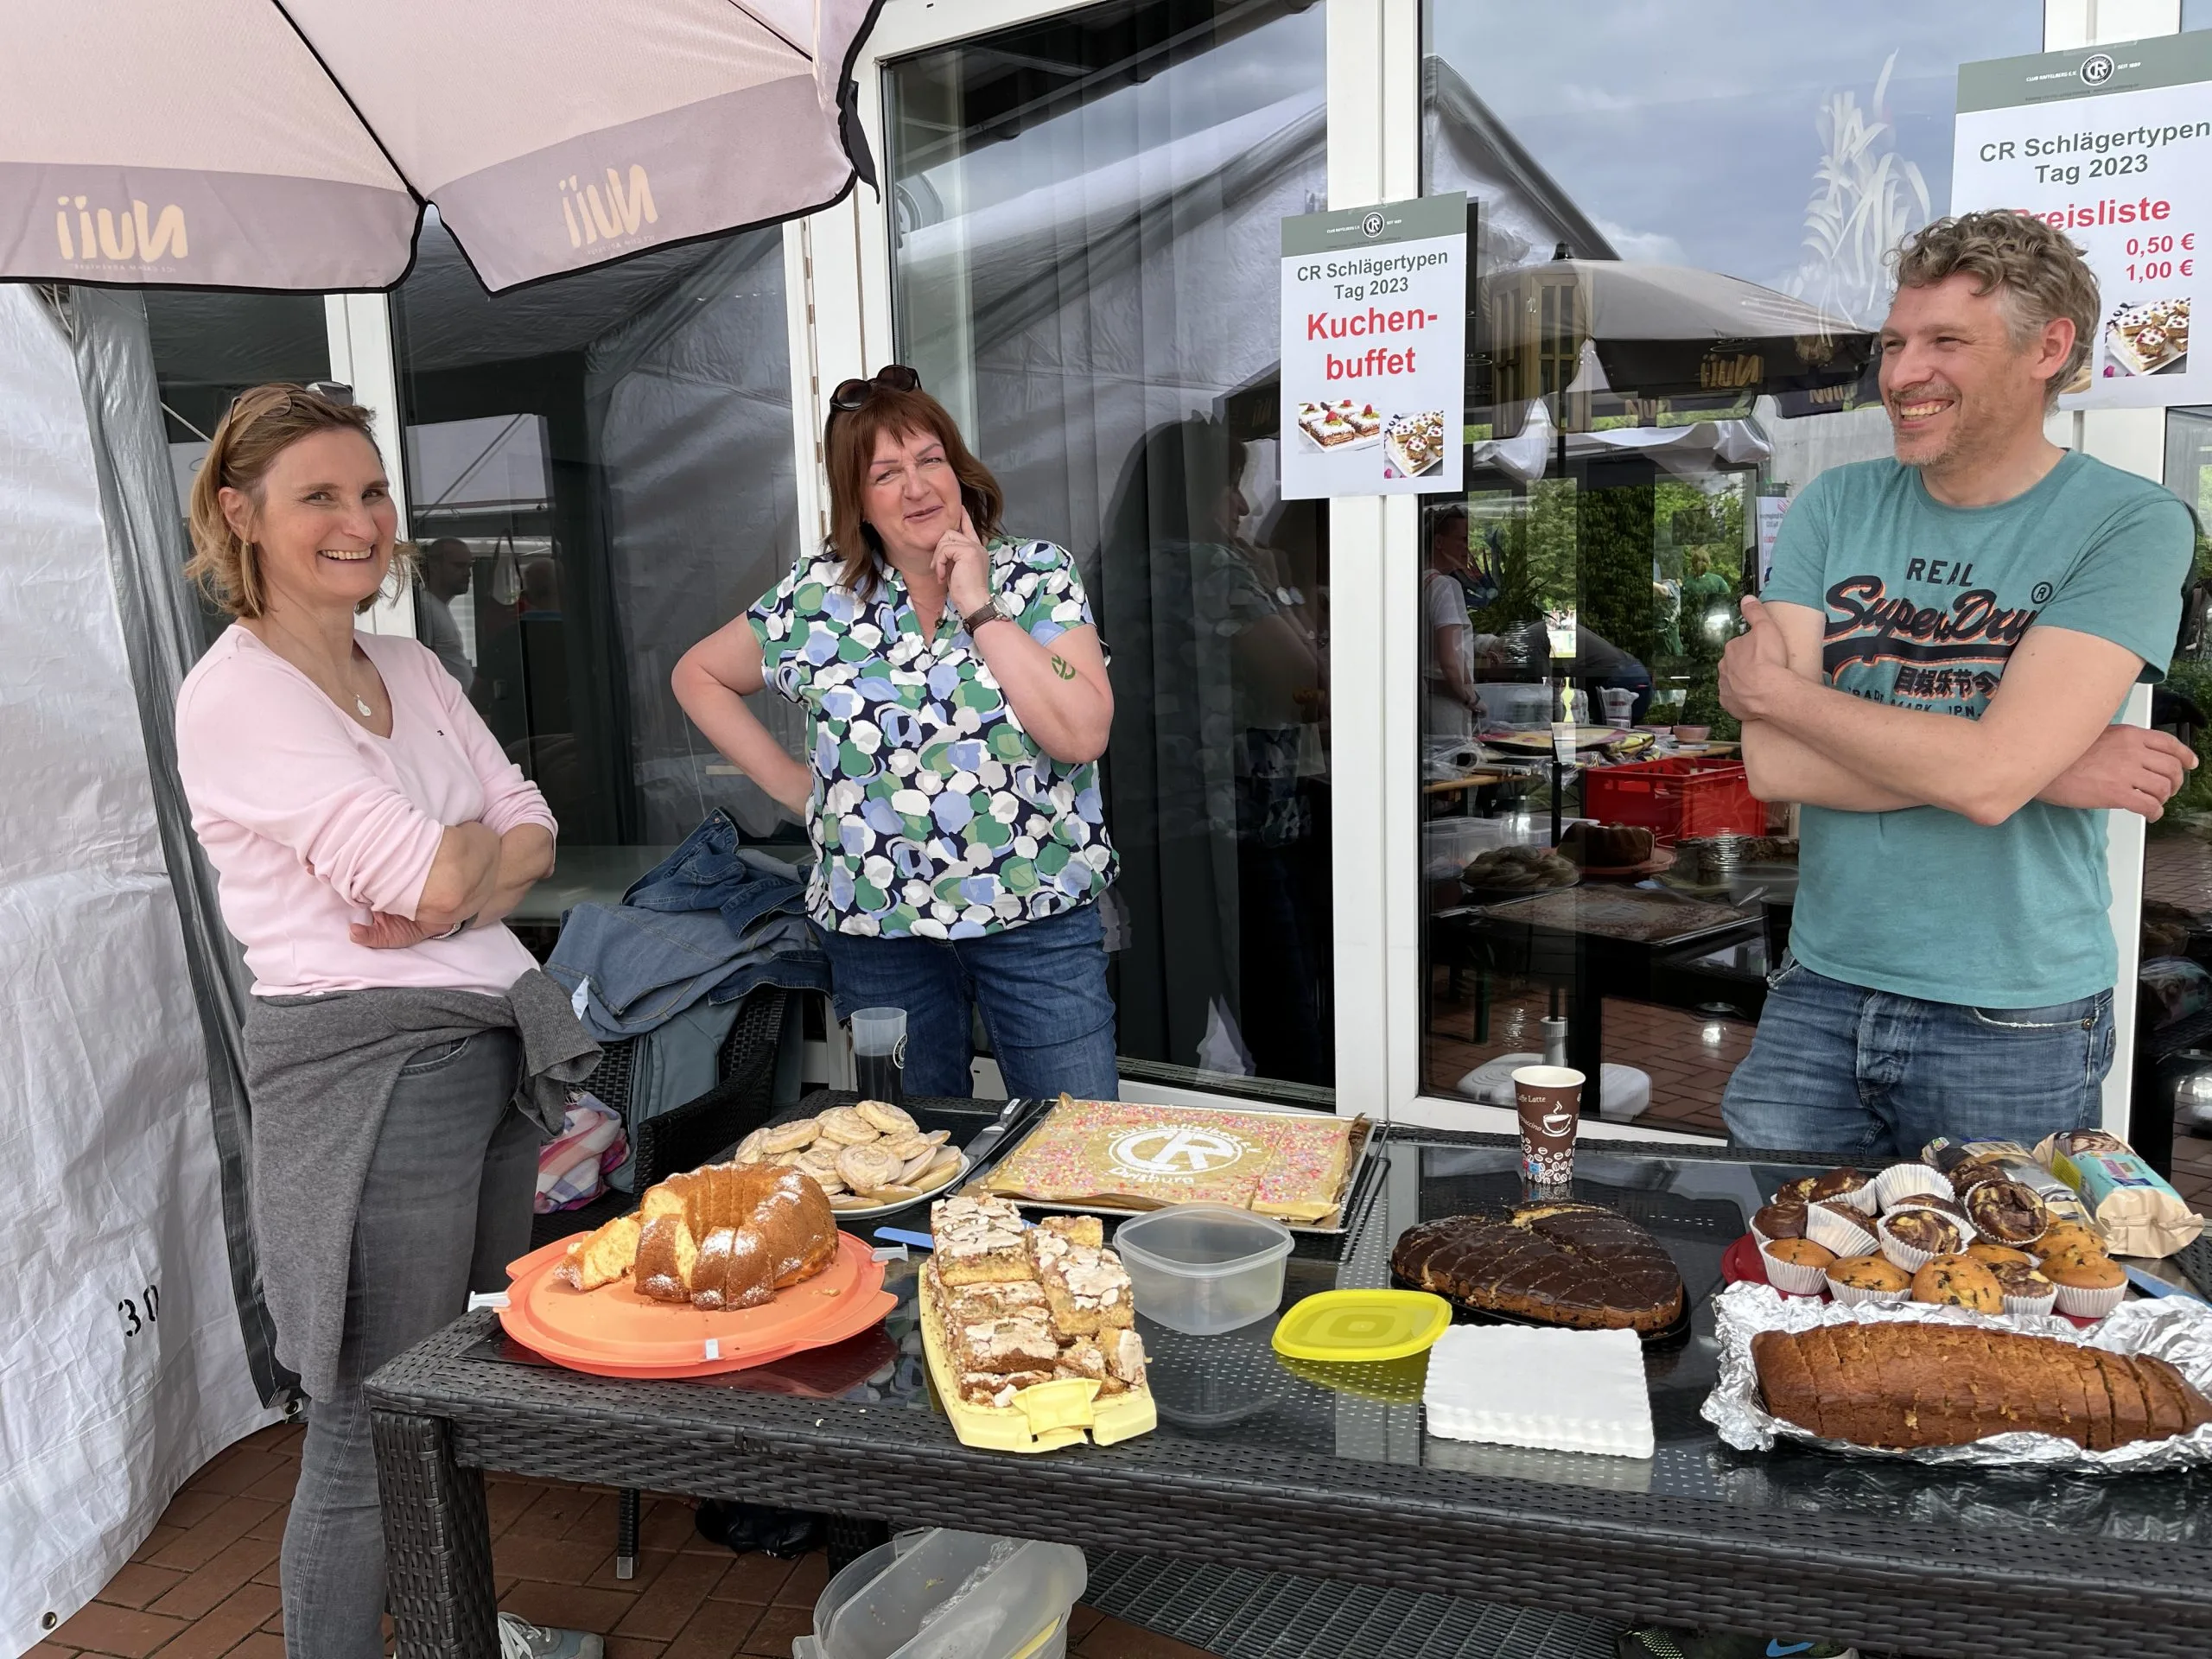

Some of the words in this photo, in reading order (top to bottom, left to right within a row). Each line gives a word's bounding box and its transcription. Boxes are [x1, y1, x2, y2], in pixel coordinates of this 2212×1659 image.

[1980, 141, 2016, 162] CR
[2024, 121, 2211, 157] Schlägertypen
[2035, 164, 2080, 185] Tag
[2088, 154, 2148, 178] 2023
[2126, 235, 2174, 258] 0,50
[2181, 233, 2195, 251] €
[1297, 265, 1322, 282] CR
[1326, 251, 1448, 278] Schlägertypen
[2126, 261, 2172, 283] 1,00
[2179, 259, 2194, 276] €
[1333, 284, 1364, 301] Tag
[1370, 276, 1408, 296] 2023
[1307, 307, 1438, 341] Kuchen-
[1326, 346, 1416, 380] buffet
[1906, 557, 1974, 588] REAL
[1528, 1095, 1546, 1103] Latte
